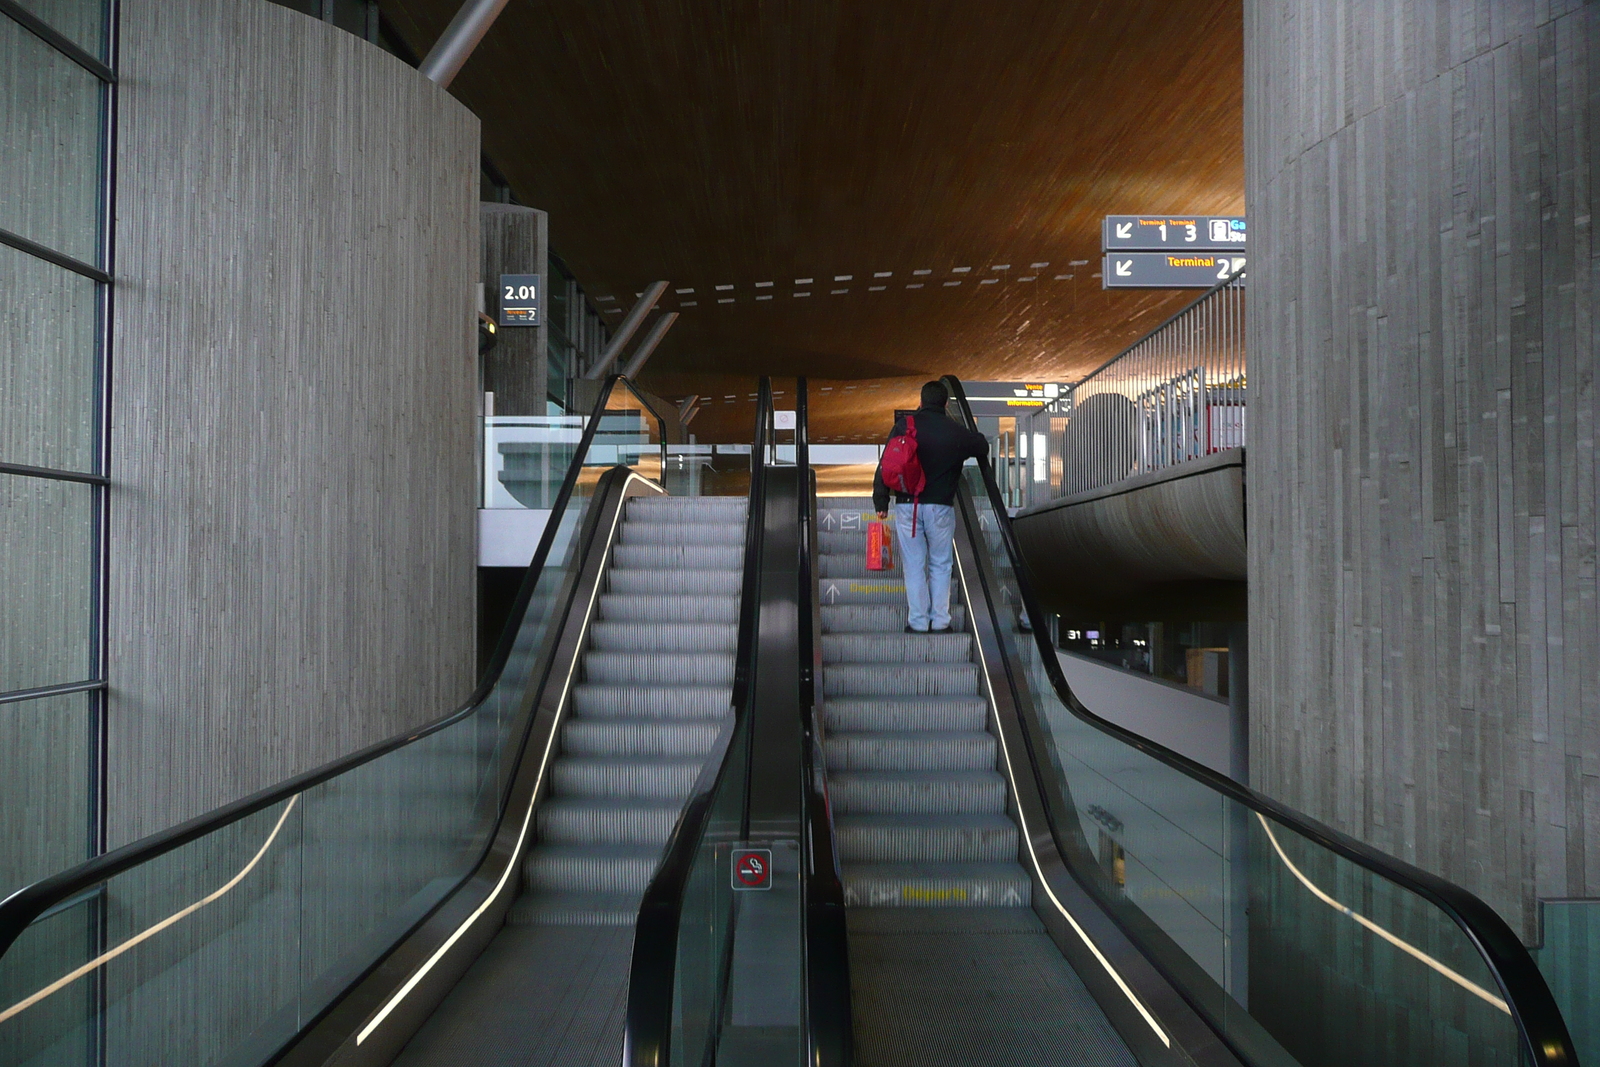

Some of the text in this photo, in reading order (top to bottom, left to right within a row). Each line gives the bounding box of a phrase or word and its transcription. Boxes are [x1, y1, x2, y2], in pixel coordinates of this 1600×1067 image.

[1158, 225, 1197, 242] 1 3
[1167, 256, 1214, 267] Terminal
[504, 285, 535, 299] 2.01
[528, 310, 535, 320] 2
[1067, 625, 1081, 639] 31
